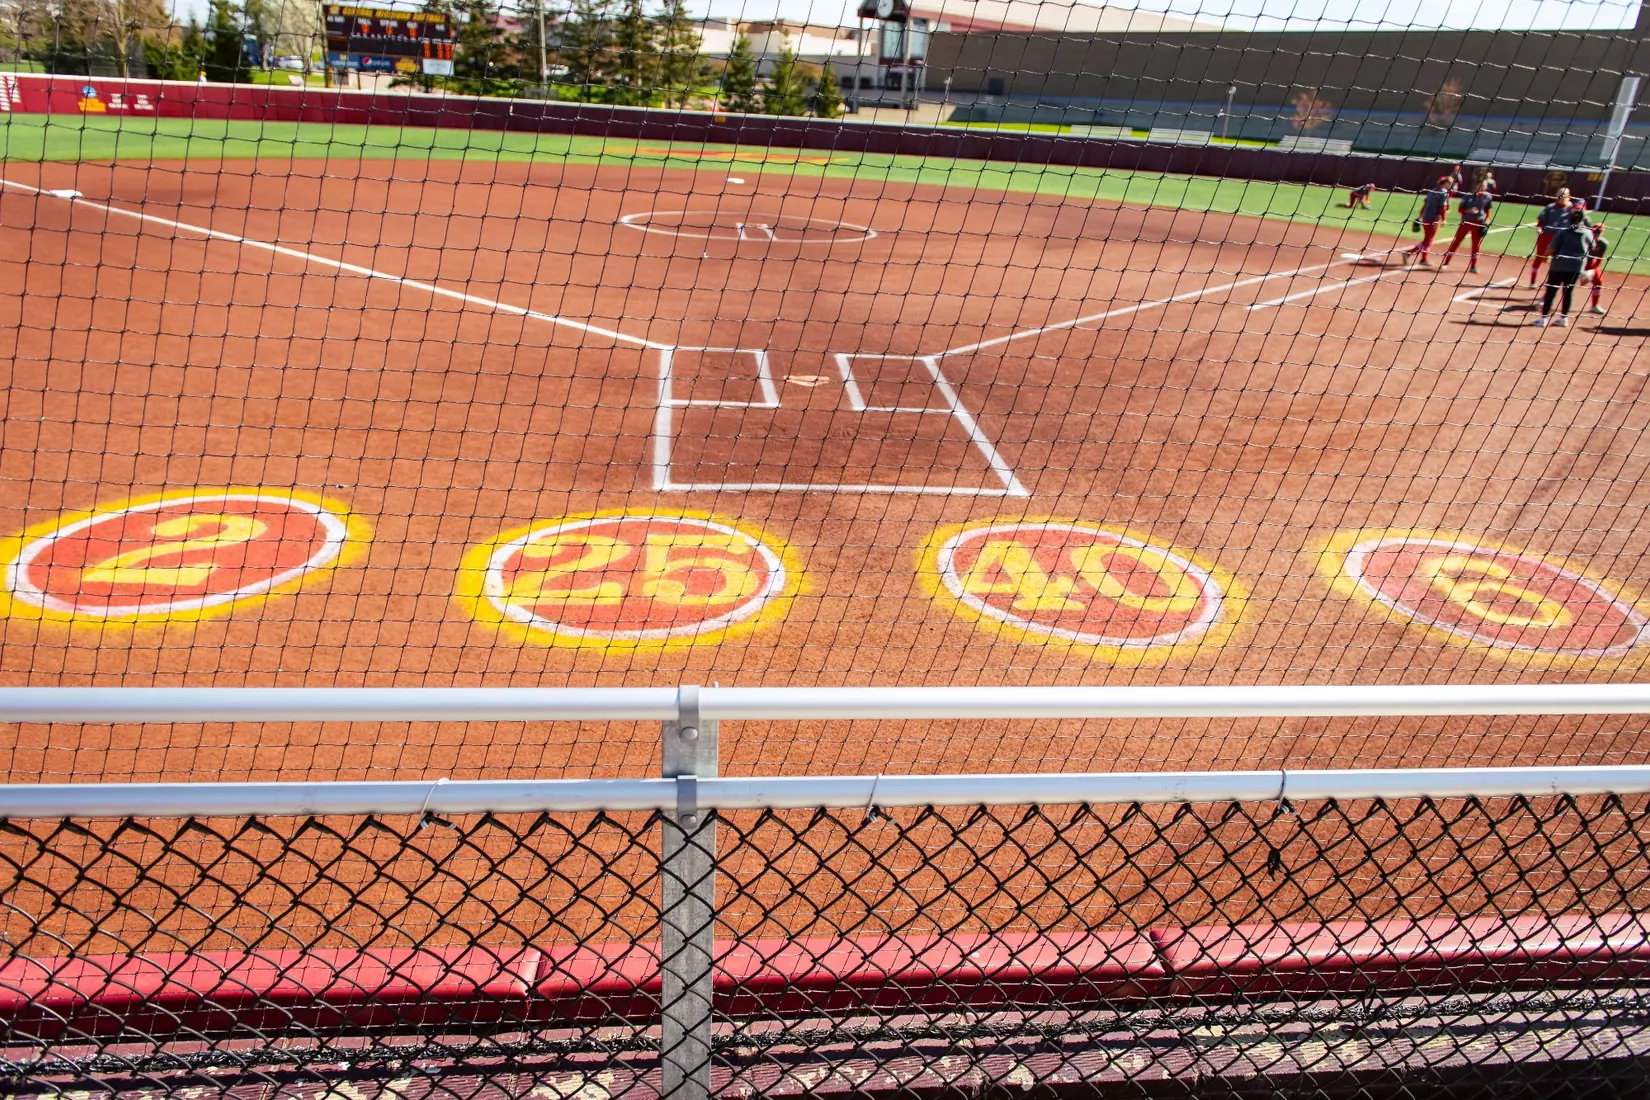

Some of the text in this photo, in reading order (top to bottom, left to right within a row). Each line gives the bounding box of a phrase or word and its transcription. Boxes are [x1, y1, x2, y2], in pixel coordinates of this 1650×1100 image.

[81, 514, 268, 586] 2
[500, 534, 759, 606] 25
[960, 541, 1200, 612] 40
[1424, 556, 1574, 628] 6
